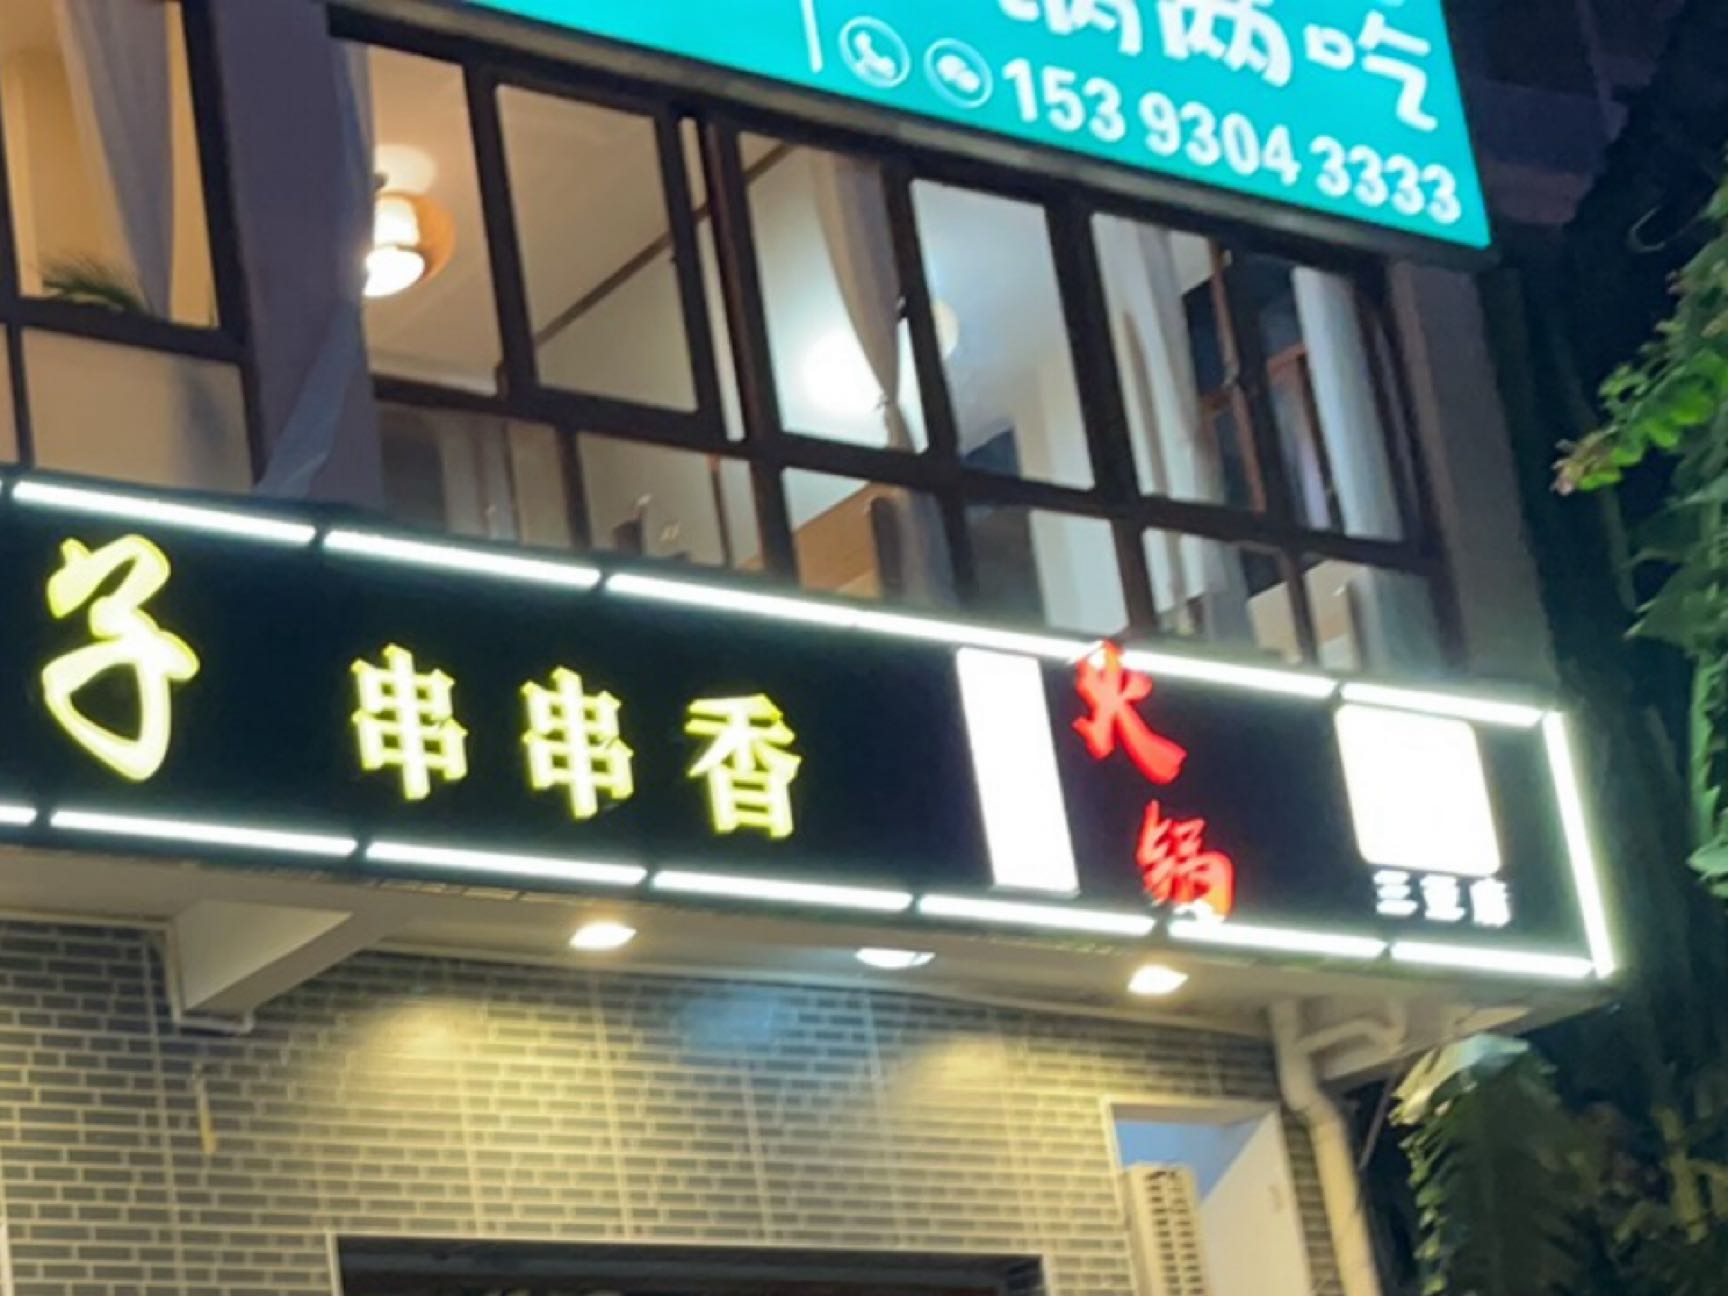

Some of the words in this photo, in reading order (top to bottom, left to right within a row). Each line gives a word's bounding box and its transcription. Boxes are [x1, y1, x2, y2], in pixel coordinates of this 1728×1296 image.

[1003, 57, 1126, 142] 153
[1139, 91, 1301, 185] 9304
[1309, 135, 1462, 224] 3333
[350, 643, 803, 839] 串串香
[1072, 640, 1236, 922] 火锅
